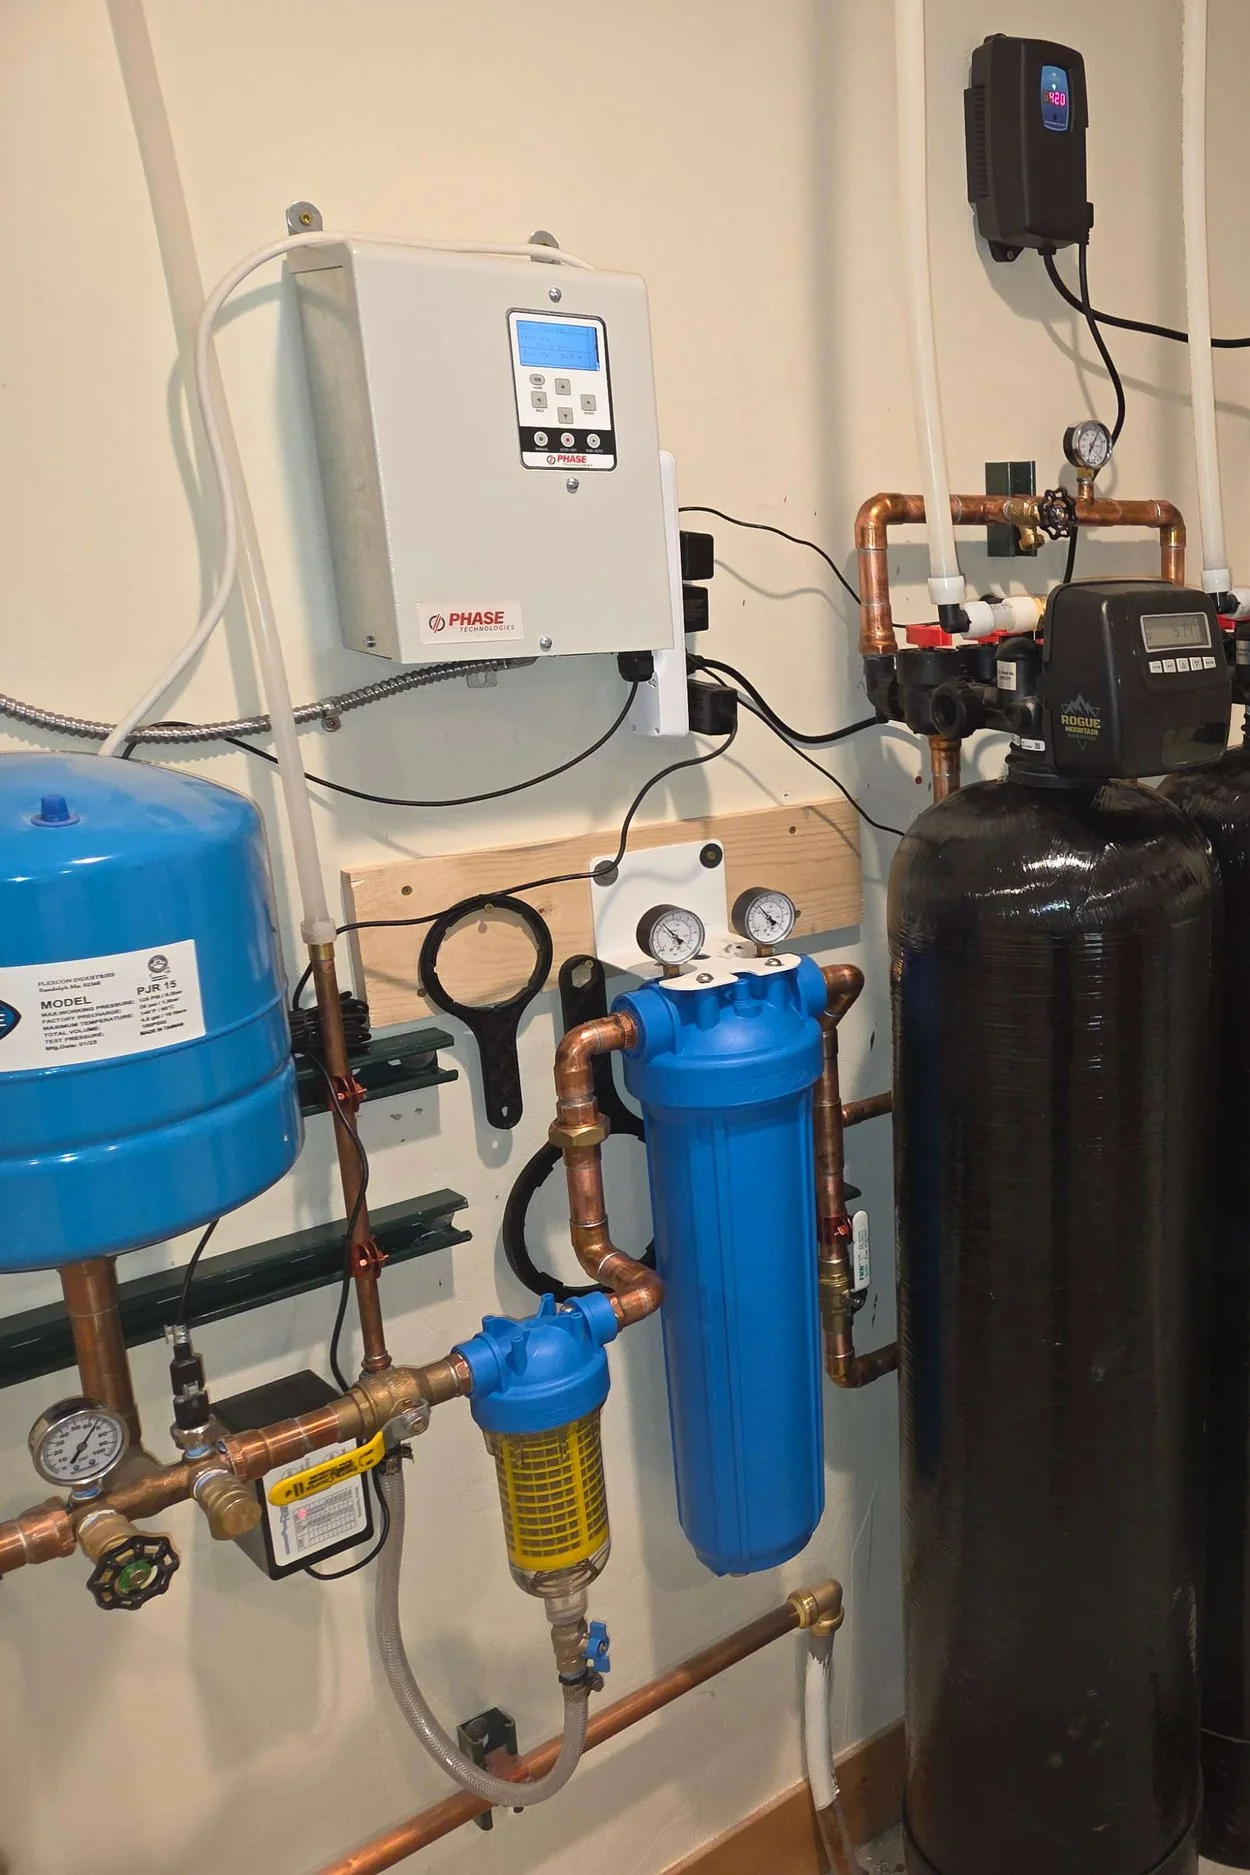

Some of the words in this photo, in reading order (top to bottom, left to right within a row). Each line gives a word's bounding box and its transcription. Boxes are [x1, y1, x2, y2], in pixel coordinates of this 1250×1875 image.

[1049, 91, 1066, 106] 420
[557, 455, 587, 463] PHASE
[448, 611, 504, 626] PHASE
[459, 624, 515, 633] TECHNOLOGIES
[1061, 714, 1101, 729] ROGUE
[1065, 725, 1099, 736] MOUNTAIN
[38, 978, 72, 987] FLEXCON
[136, 983, 161, 996] PJR
[163, 980, 177, 990] 15
[40, 996, 92, 1010] MODEL
[42, 1015, 75, 1024] FACTORY
[43, 1022, 78, 1031] MAXIMUM
[44, 1030, 67, 1038] TOTAL
